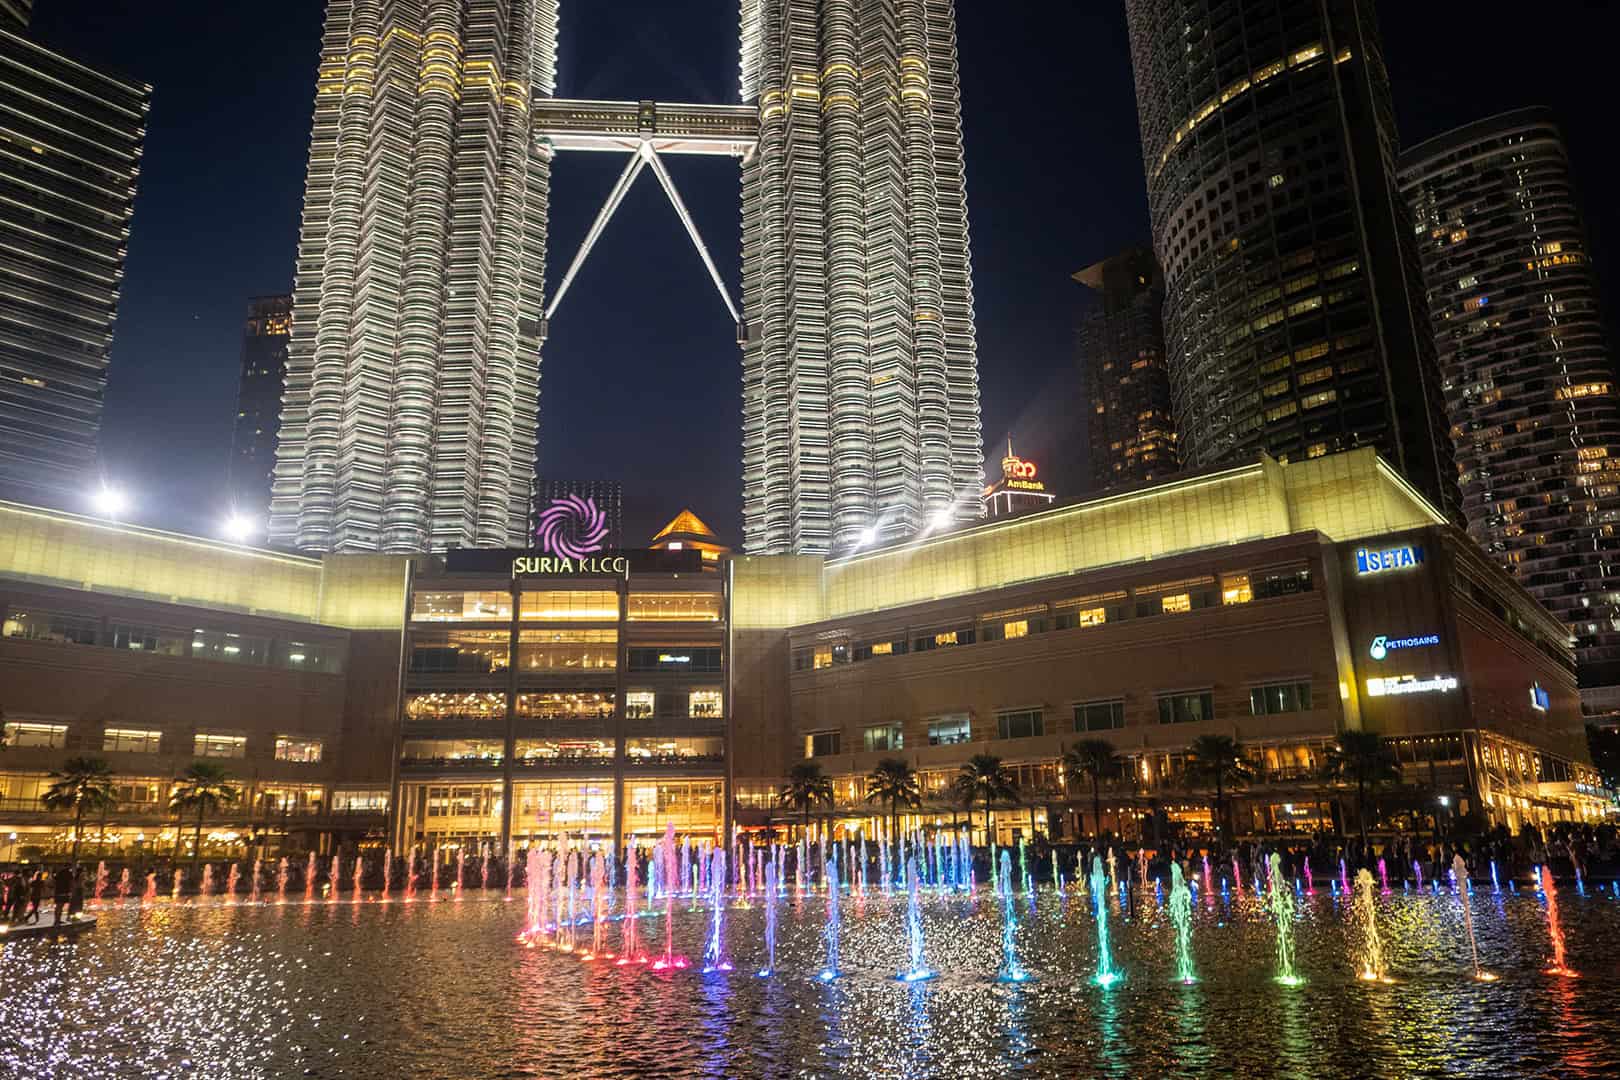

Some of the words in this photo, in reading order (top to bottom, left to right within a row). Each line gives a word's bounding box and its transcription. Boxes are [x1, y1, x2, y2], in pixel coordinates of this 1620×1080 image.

[1007, 479, 1045, 490] AmBank
[515, 557, 573, 573] SURIA
[579, 557, 625, 573] KLCC
[1385, 635, 1439, 649] PETROSAINS
